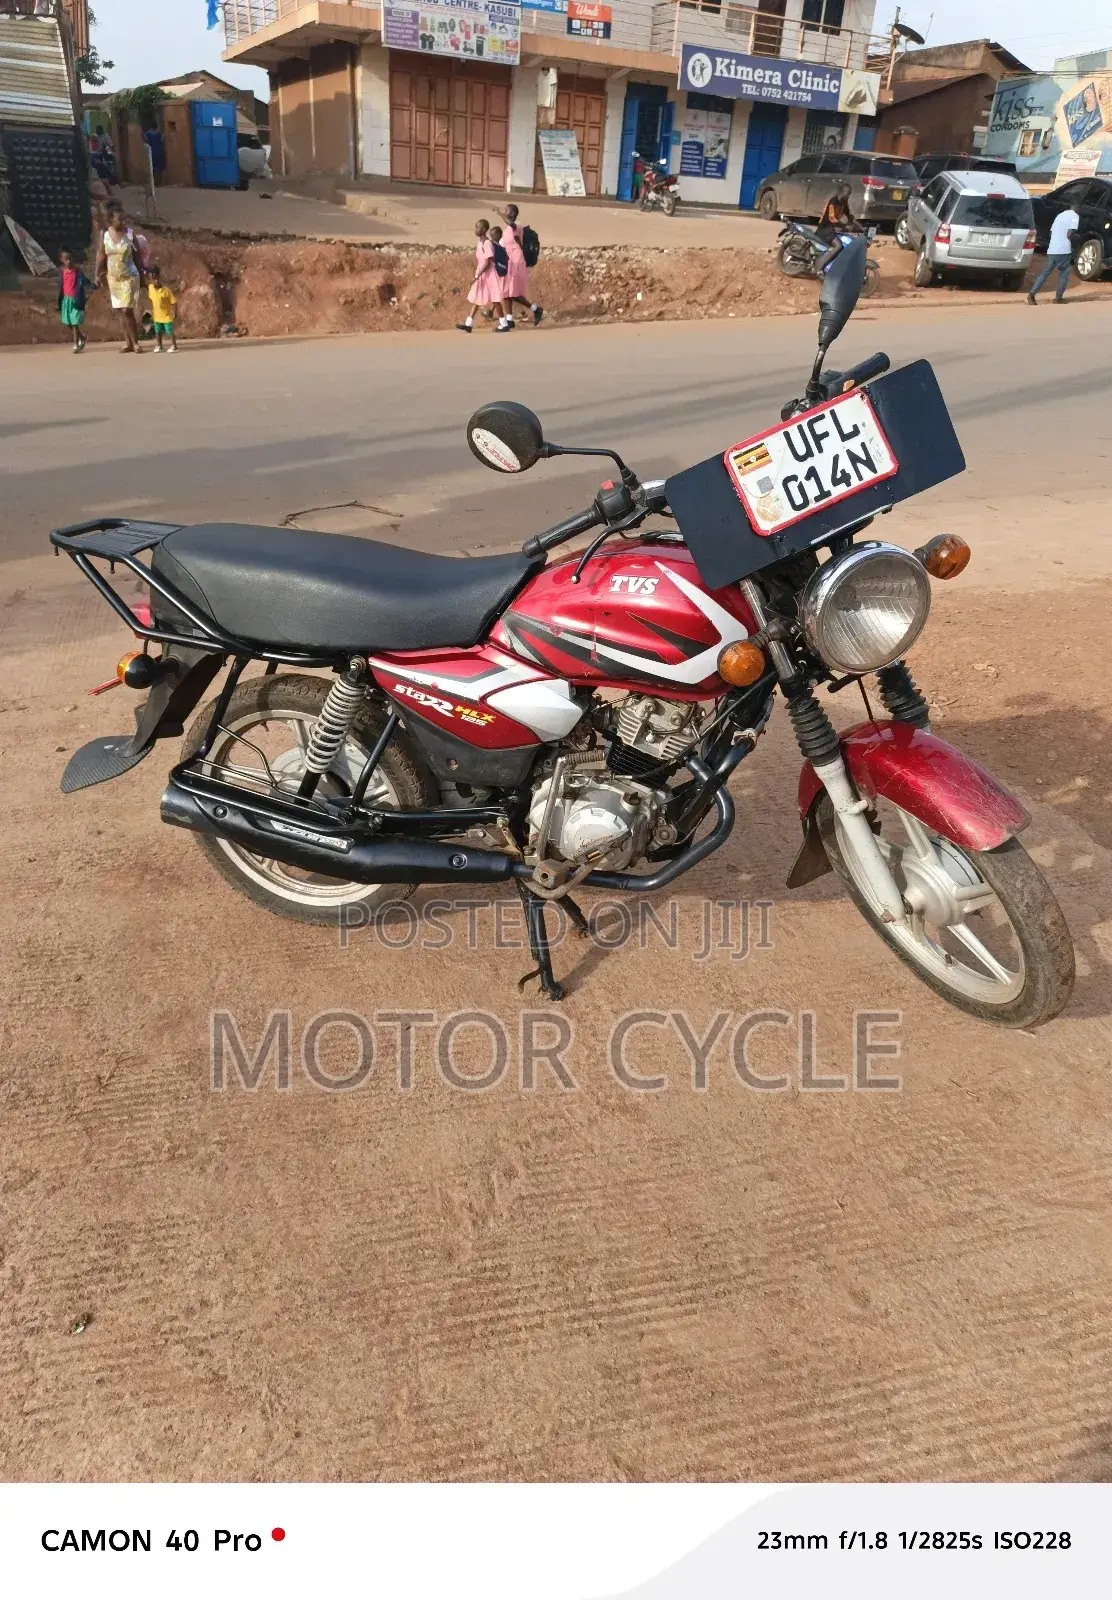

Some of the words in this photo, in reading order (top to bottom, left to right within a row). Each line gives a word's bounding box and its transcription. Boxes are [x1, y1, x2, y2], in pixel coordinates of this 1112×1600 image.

[484, 3, 517, 18] KASUBI
[714, 57, 782, 86] Kimera
[787, 69, 840, 94] Clinic
[742, 84, 760, 96] TEL:
[762, 88, 781, 99] 0752
[783, 91, 812, 103] 421754
[990, 121, 1031, 133] CONDOMS
[783, 408, 861, 463] UFL
[782, 441, 878, 512] 014N
[609, 574, 660, 595] TVS
[455, 705, 497, 723] HLX
[460, 714, 487, 727] 125
